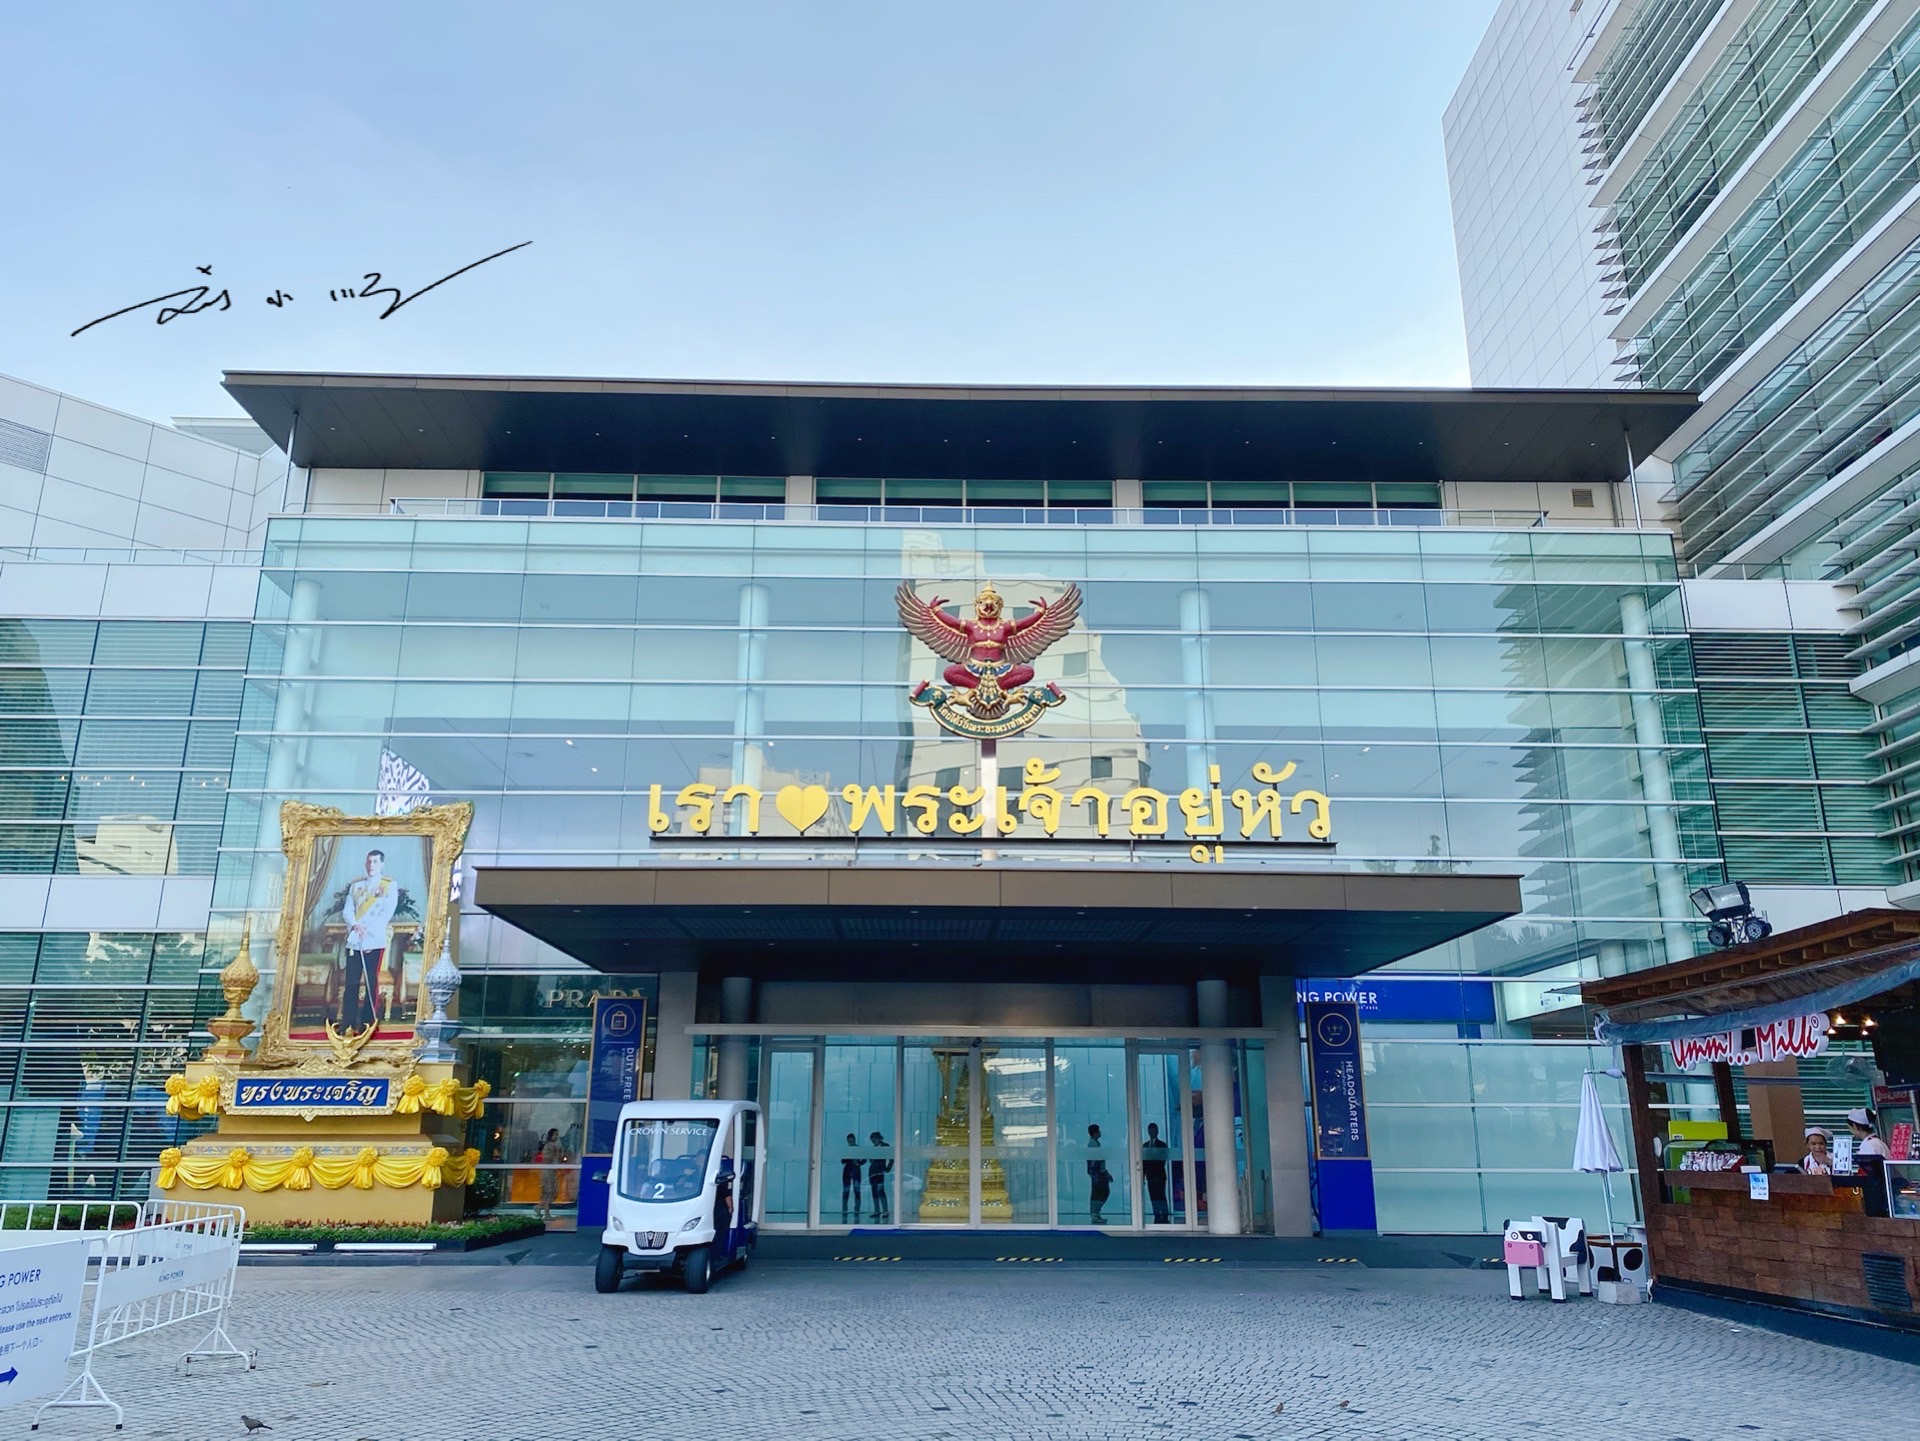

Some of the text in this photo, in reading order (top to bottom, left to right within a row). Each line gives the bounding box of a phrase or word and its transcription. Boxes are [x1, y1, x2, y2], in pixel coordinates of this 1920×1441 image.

[648, 757, 1331, 864] เรา พระเจ้าอยู่หัว
[1324, 991, 1378, 1004] POWER
[625, 1047, 635, 1073] DUTY
[240, 1079, 383, 1106] ทรงพระเจริญ
[622, 1076, 633, 1100] FREE
[1345, 1060, 1360, 1141] HEADQUARTERS
[629, 1127, 708, 1136] CROWN SERVICE
[652, 1182, 665, 1199] 2
[7, 1268, 41, 1287] POWER
[15, 1322, 26, 1331] use
[26, 1319, 36, 1328] the
[36, 1316, 49, 1326] next
